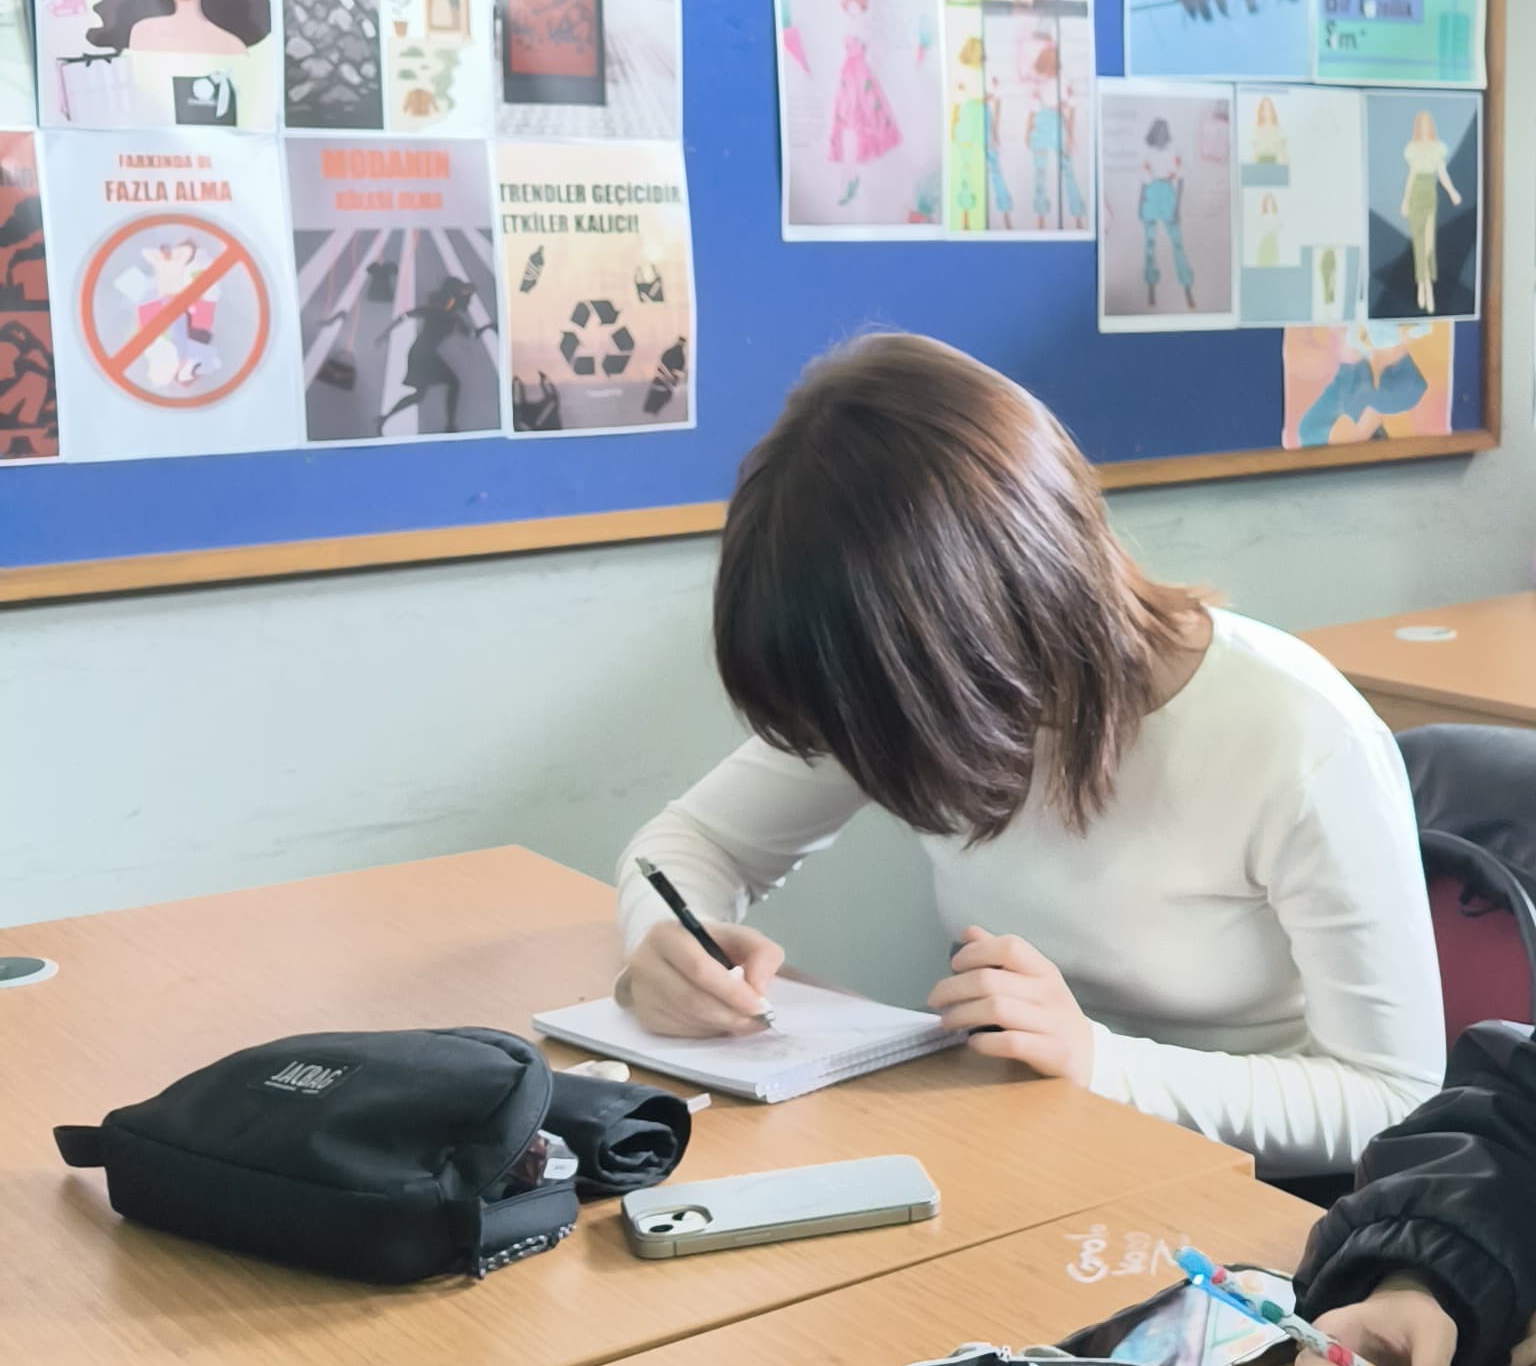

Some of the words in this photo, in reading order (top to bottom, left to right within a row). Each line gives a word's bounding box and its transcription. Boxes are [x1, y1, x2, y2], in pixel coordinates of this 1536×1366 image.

[321, 148, 450, 179] MODANIN
[104, 180, 168, 202] FAZLA
[175, 180, 233, 202] ALMA
[500, 183, 586, 204] TRENDLER
[502, 212, 569, 234] ETKİLER
